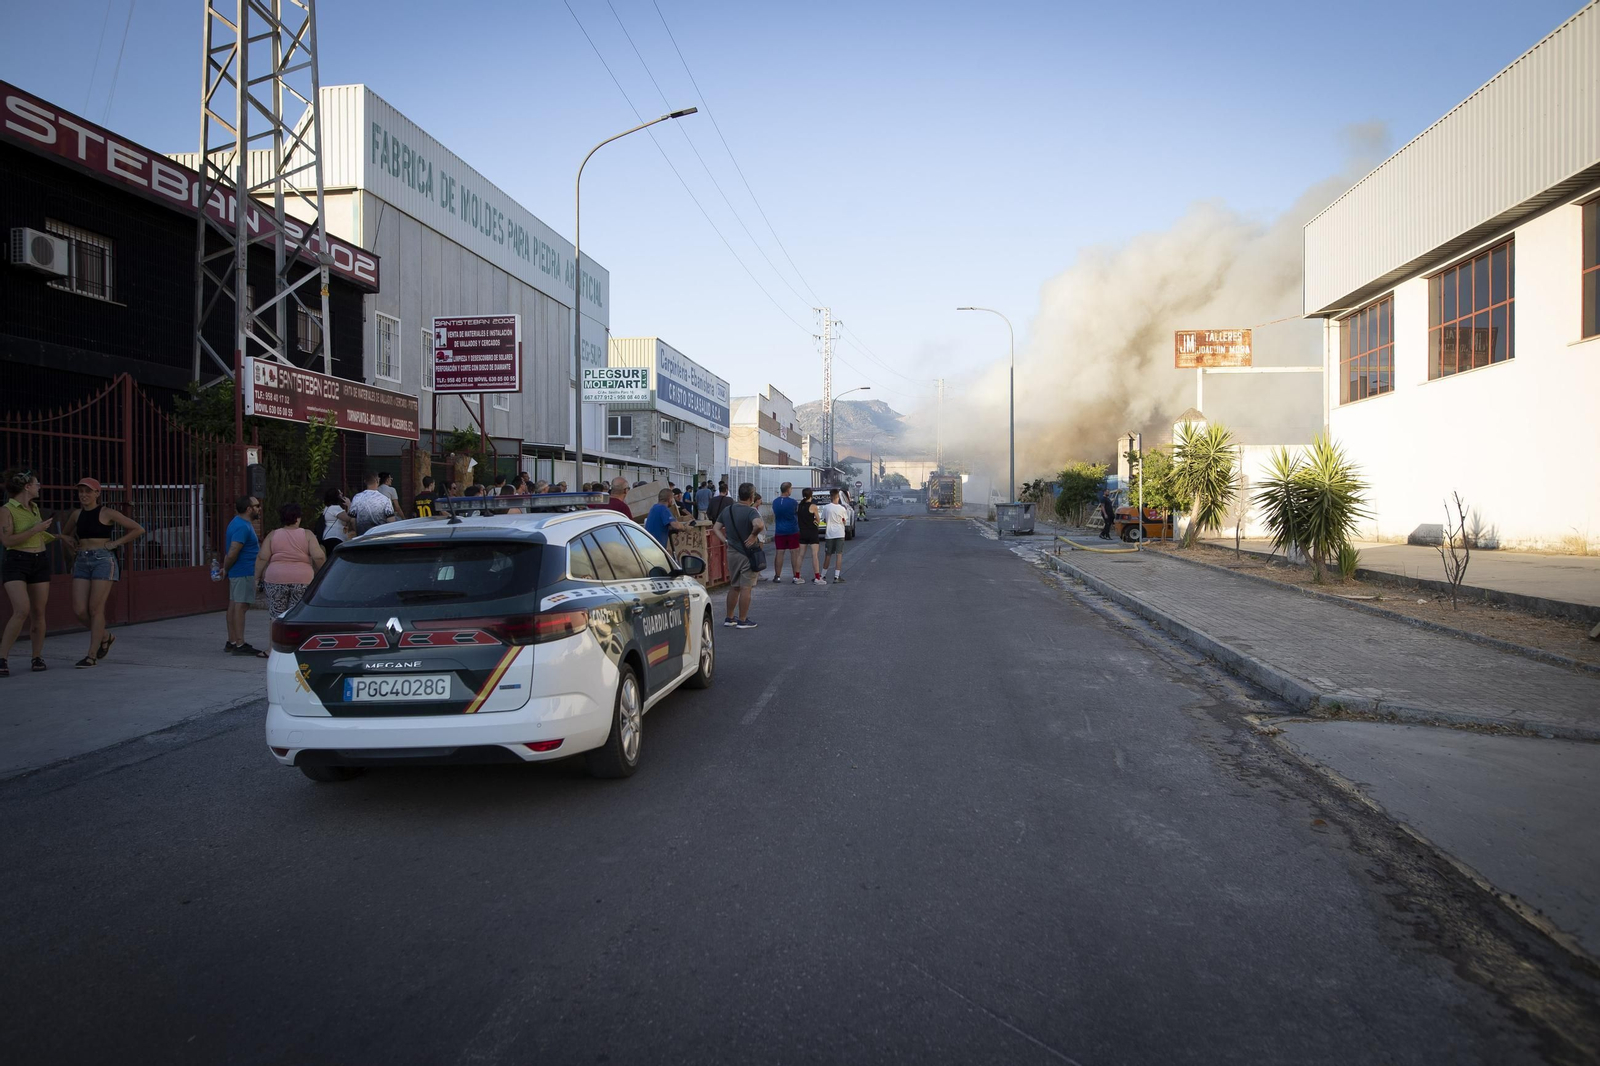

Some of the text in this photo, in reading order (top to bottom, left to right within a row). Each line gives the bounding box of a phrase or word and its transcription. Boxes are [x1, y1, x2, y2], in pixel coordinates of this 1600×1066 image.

[372, 121, 602, 307] FABRICA DE MOLDES PARA PIEDRA ARFICIAL
[465, 329, 486, 338] MATERIALES
[1204, 332, 1243, 342] TALLERES
[1229, 345, 1250, 354] MORA
[584, 370, 640, 378] PLEGSUR
[279, 369, 340, 400] SANTISTEBAN 2002
[668, 383, 687, 406] CRISTO
[688, 392, 694, 410] DE
[642, 613, 669, 636] GUARDIA
[356, 679, 446, 698] PGC4028G
